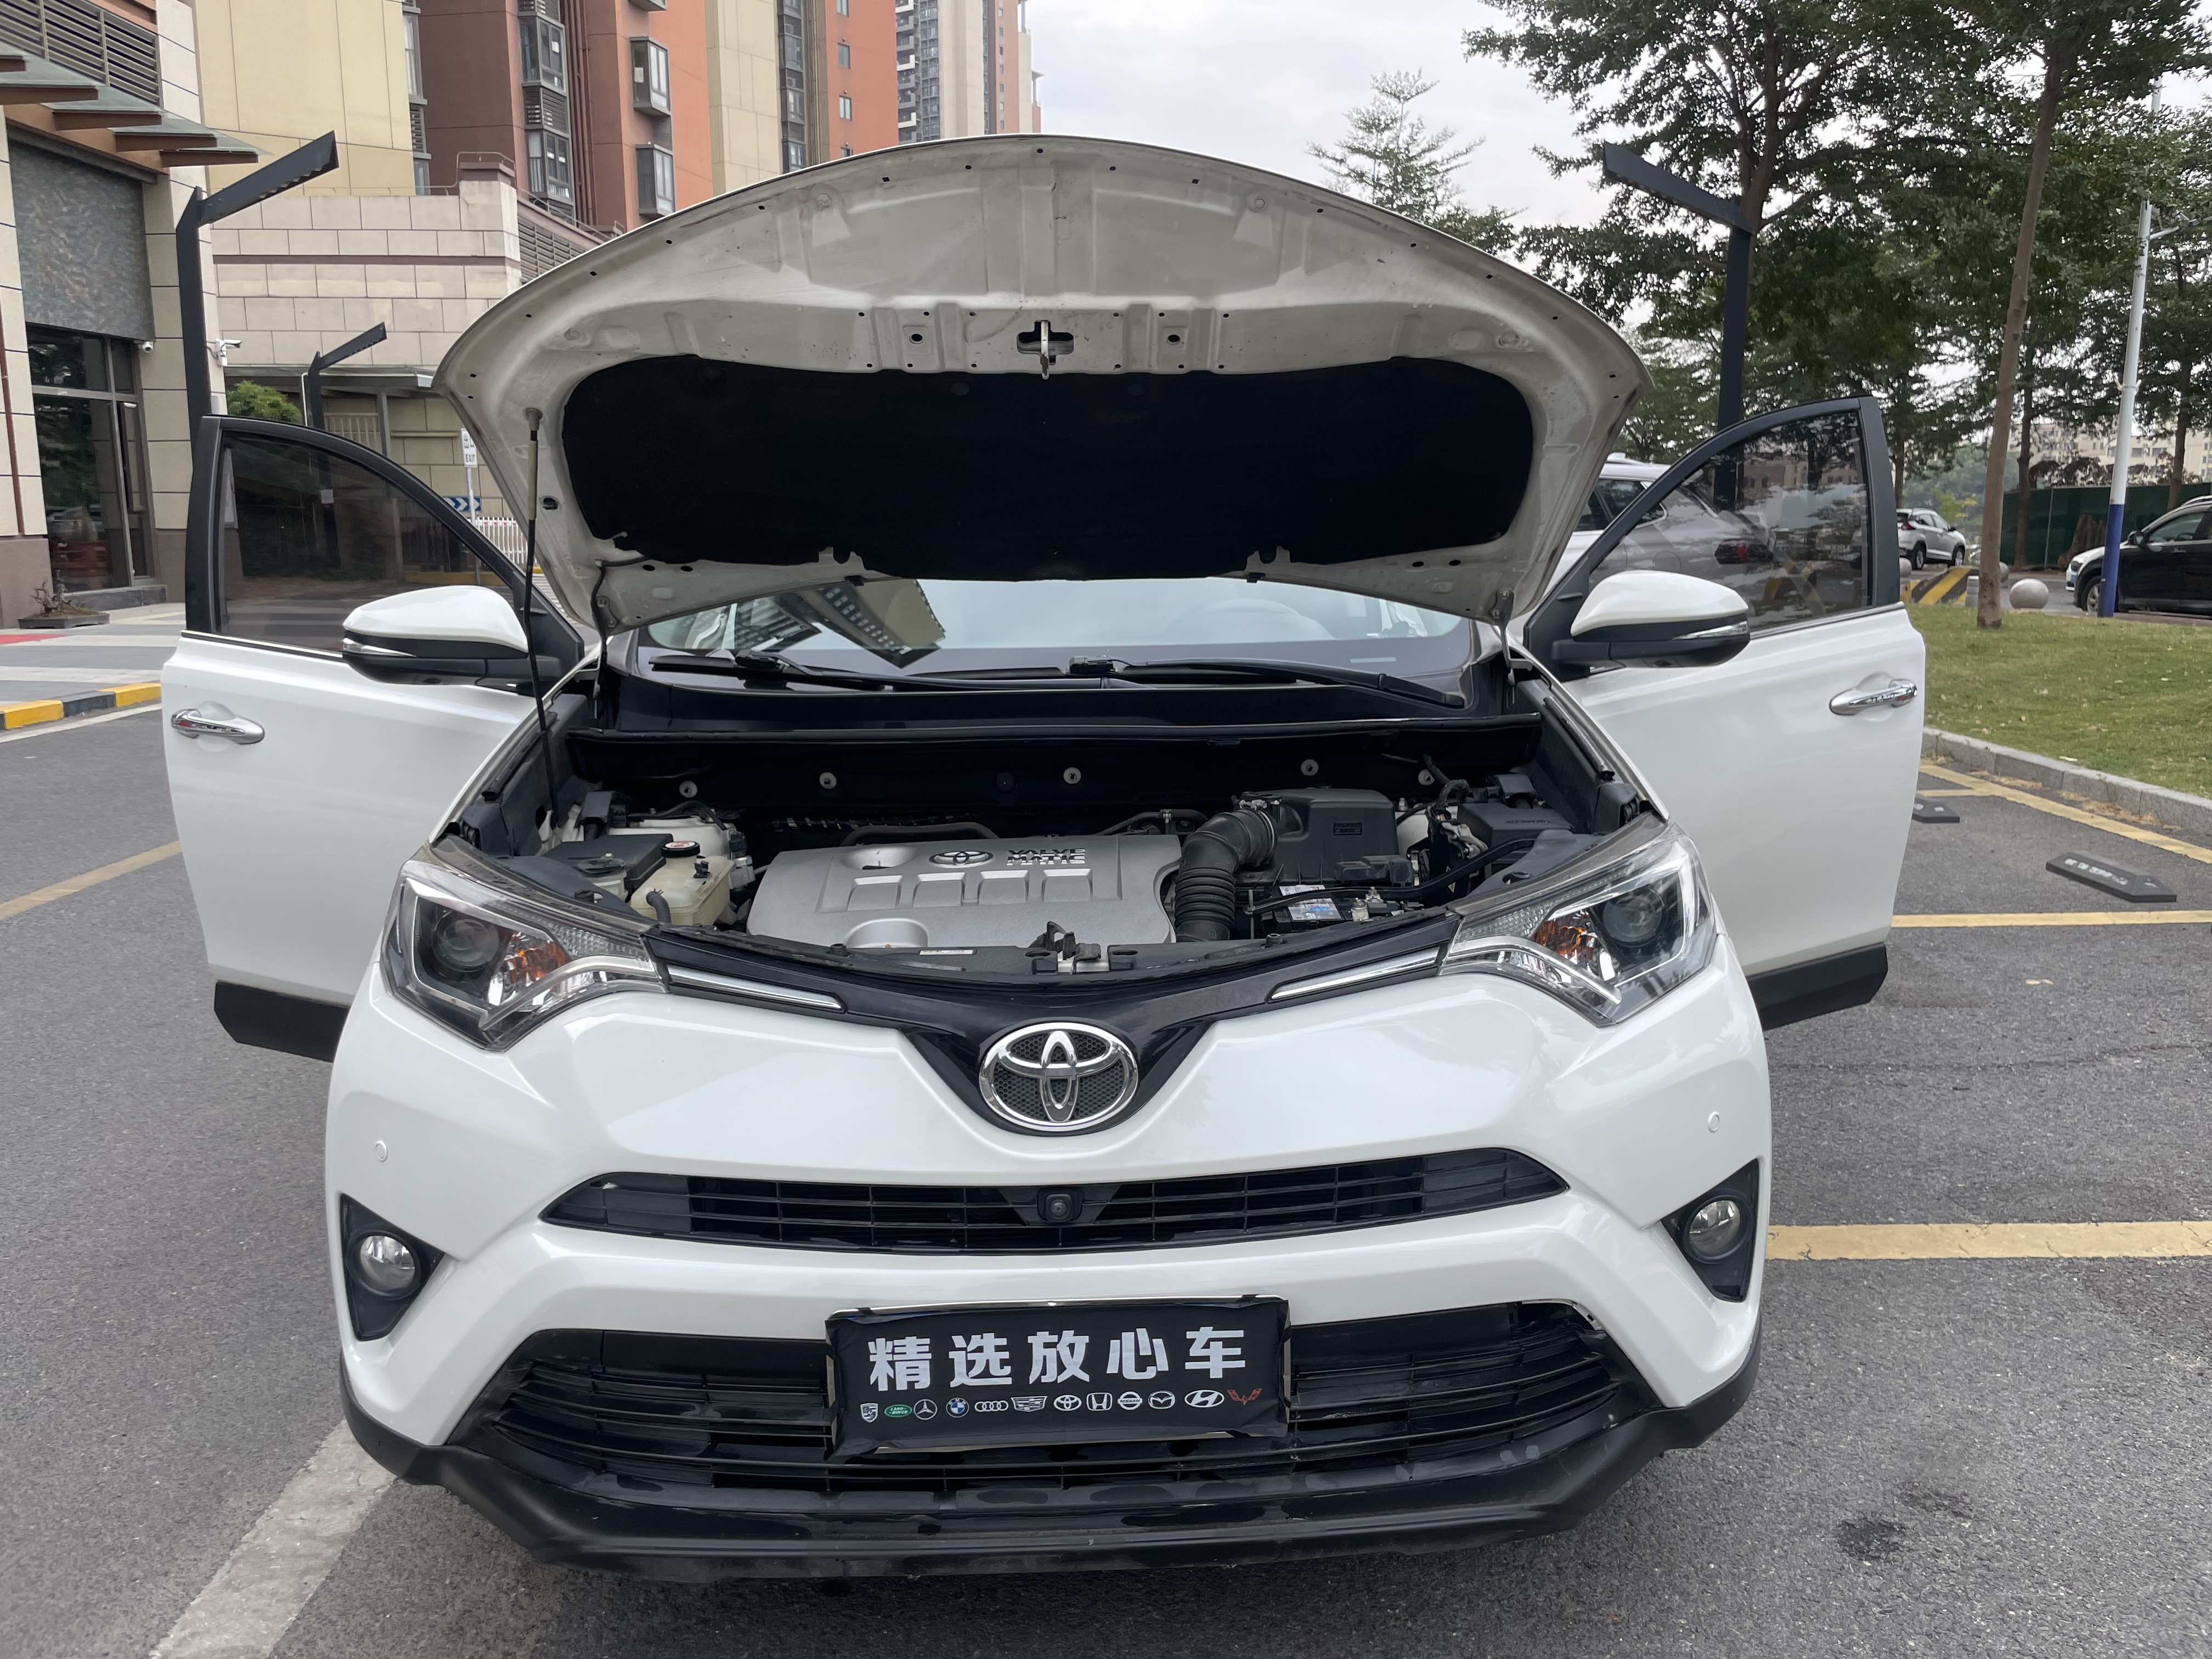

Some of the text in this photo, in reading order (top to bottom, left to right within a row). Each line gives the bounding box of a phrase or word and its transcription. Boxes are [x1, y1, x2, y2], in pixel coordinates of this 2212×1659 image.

[466, 454, 475, 462] EXIT
[1008, 848, 1085, 857] VALVE
[1006, 855, 1085, 866] MATIC
[868, 1327, 1246, 1391] 精选放心车
